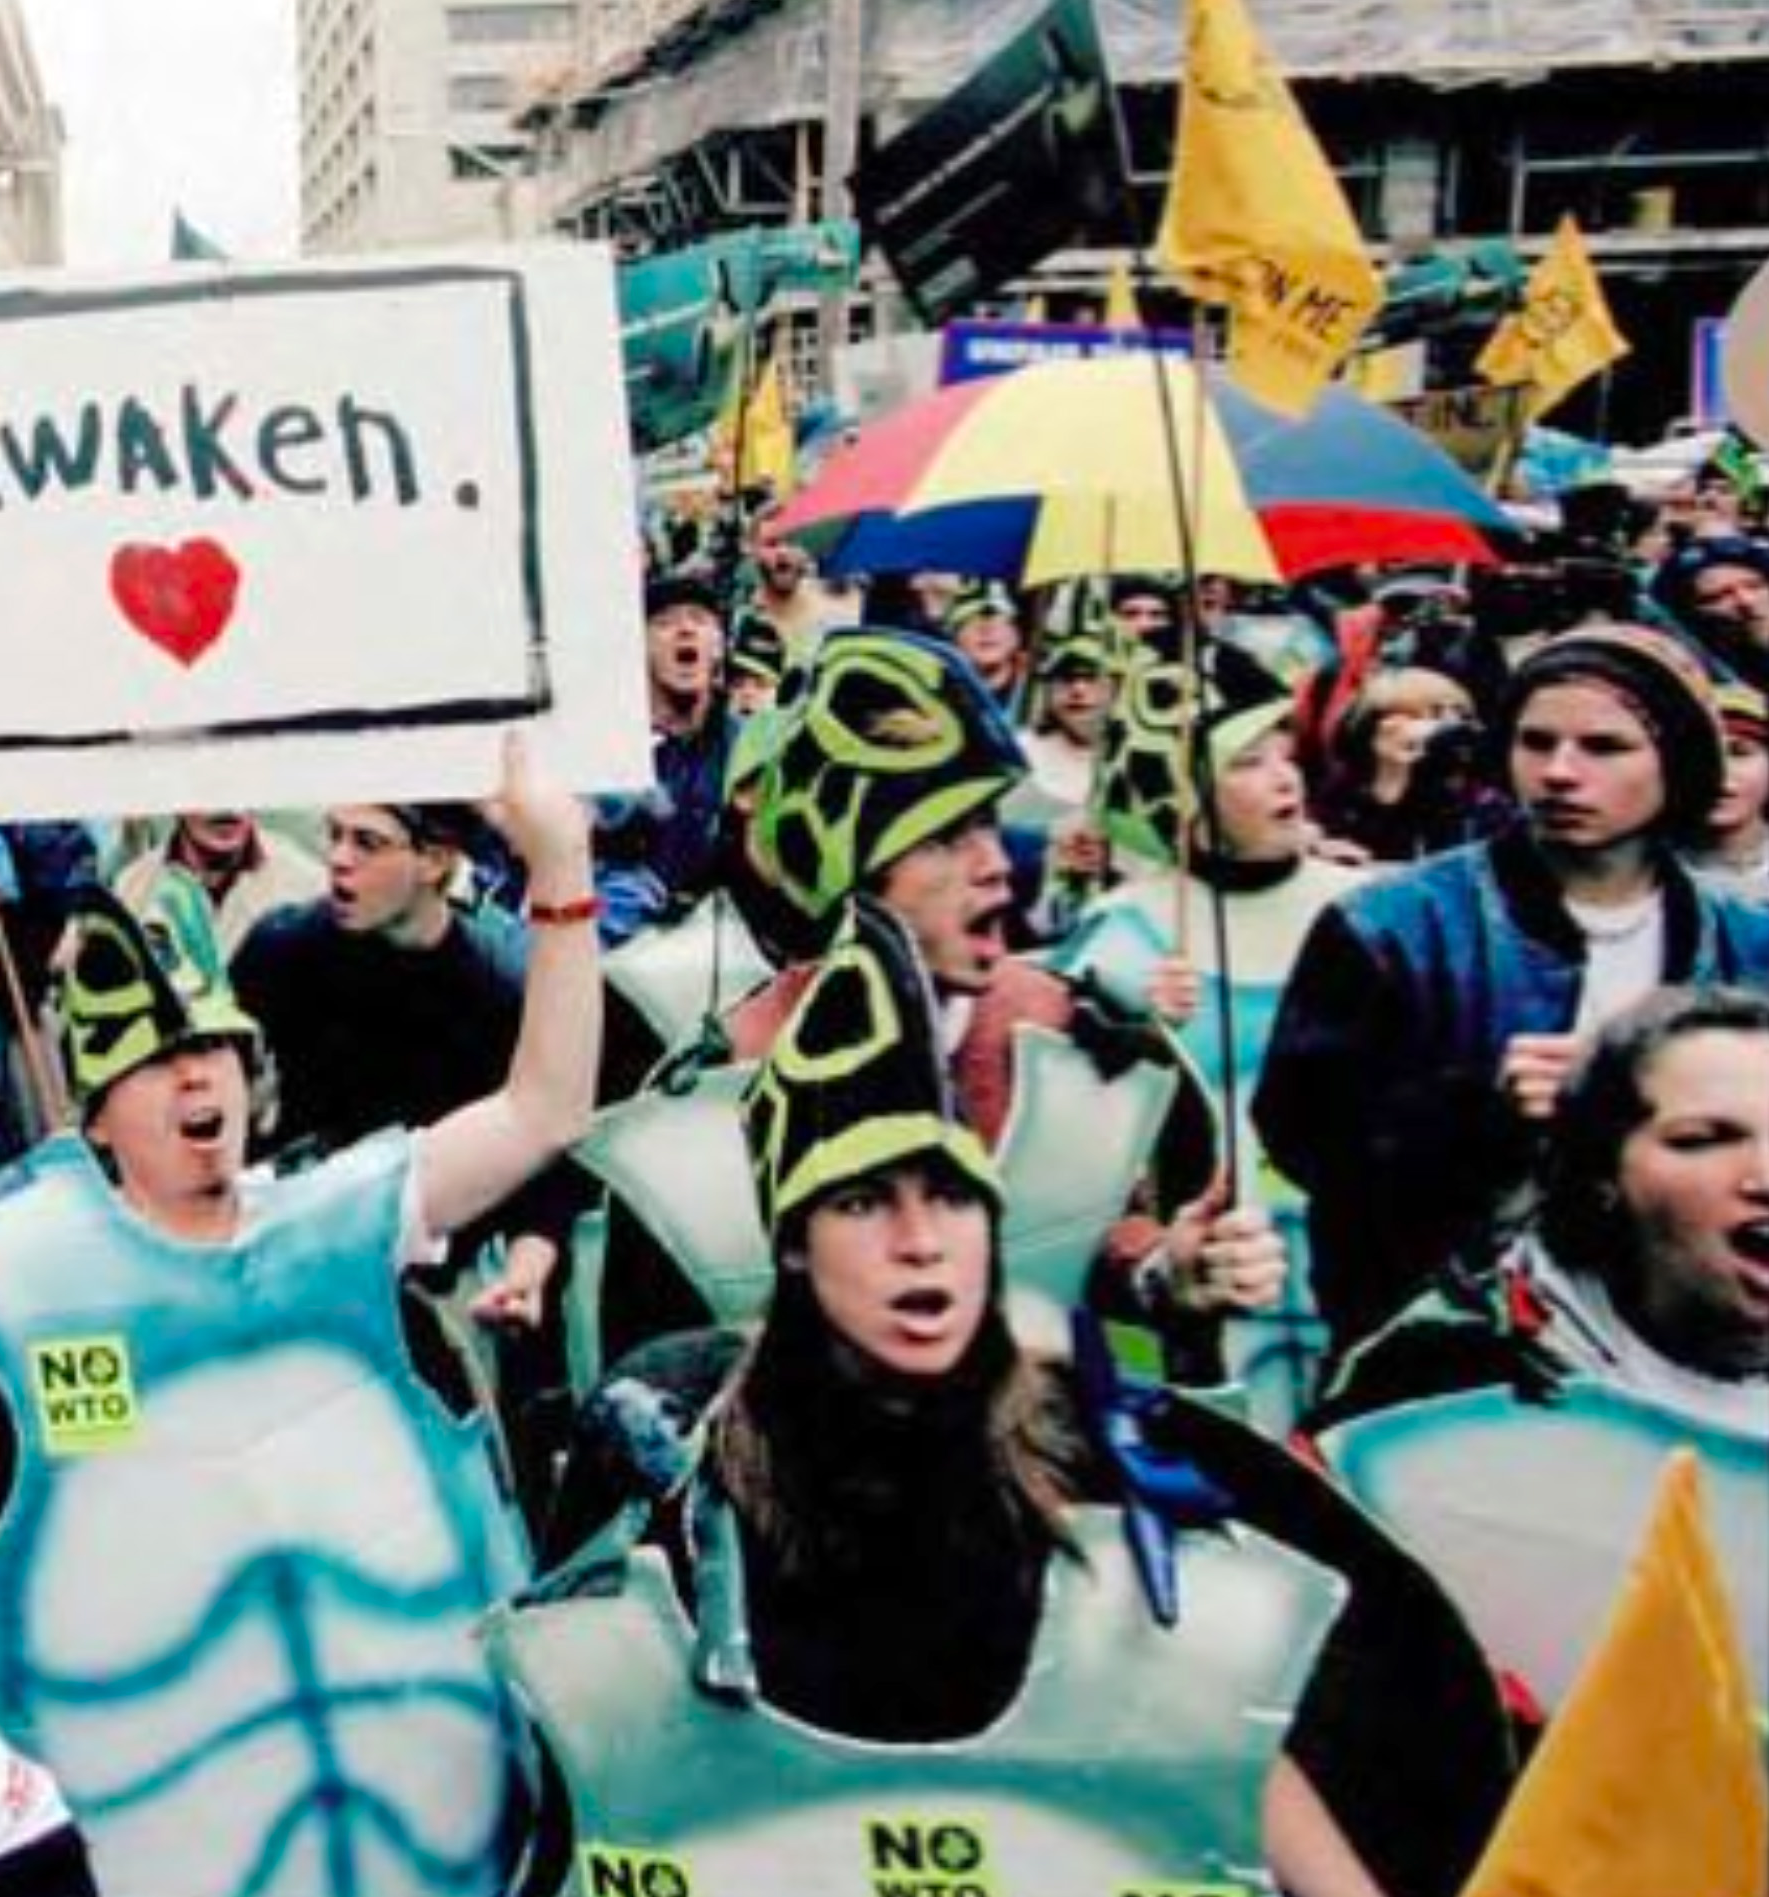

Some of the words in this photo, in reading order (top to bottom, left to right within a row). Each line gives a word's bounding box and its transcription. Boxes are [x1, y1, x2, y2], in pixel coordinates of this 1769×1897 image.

[40, 1344, 120, 1391] NO
[46, 1397, 128, 1424] WTO
[868, 1823, 983, 1874] NO
[590, 1853, 689, 1897] NO
